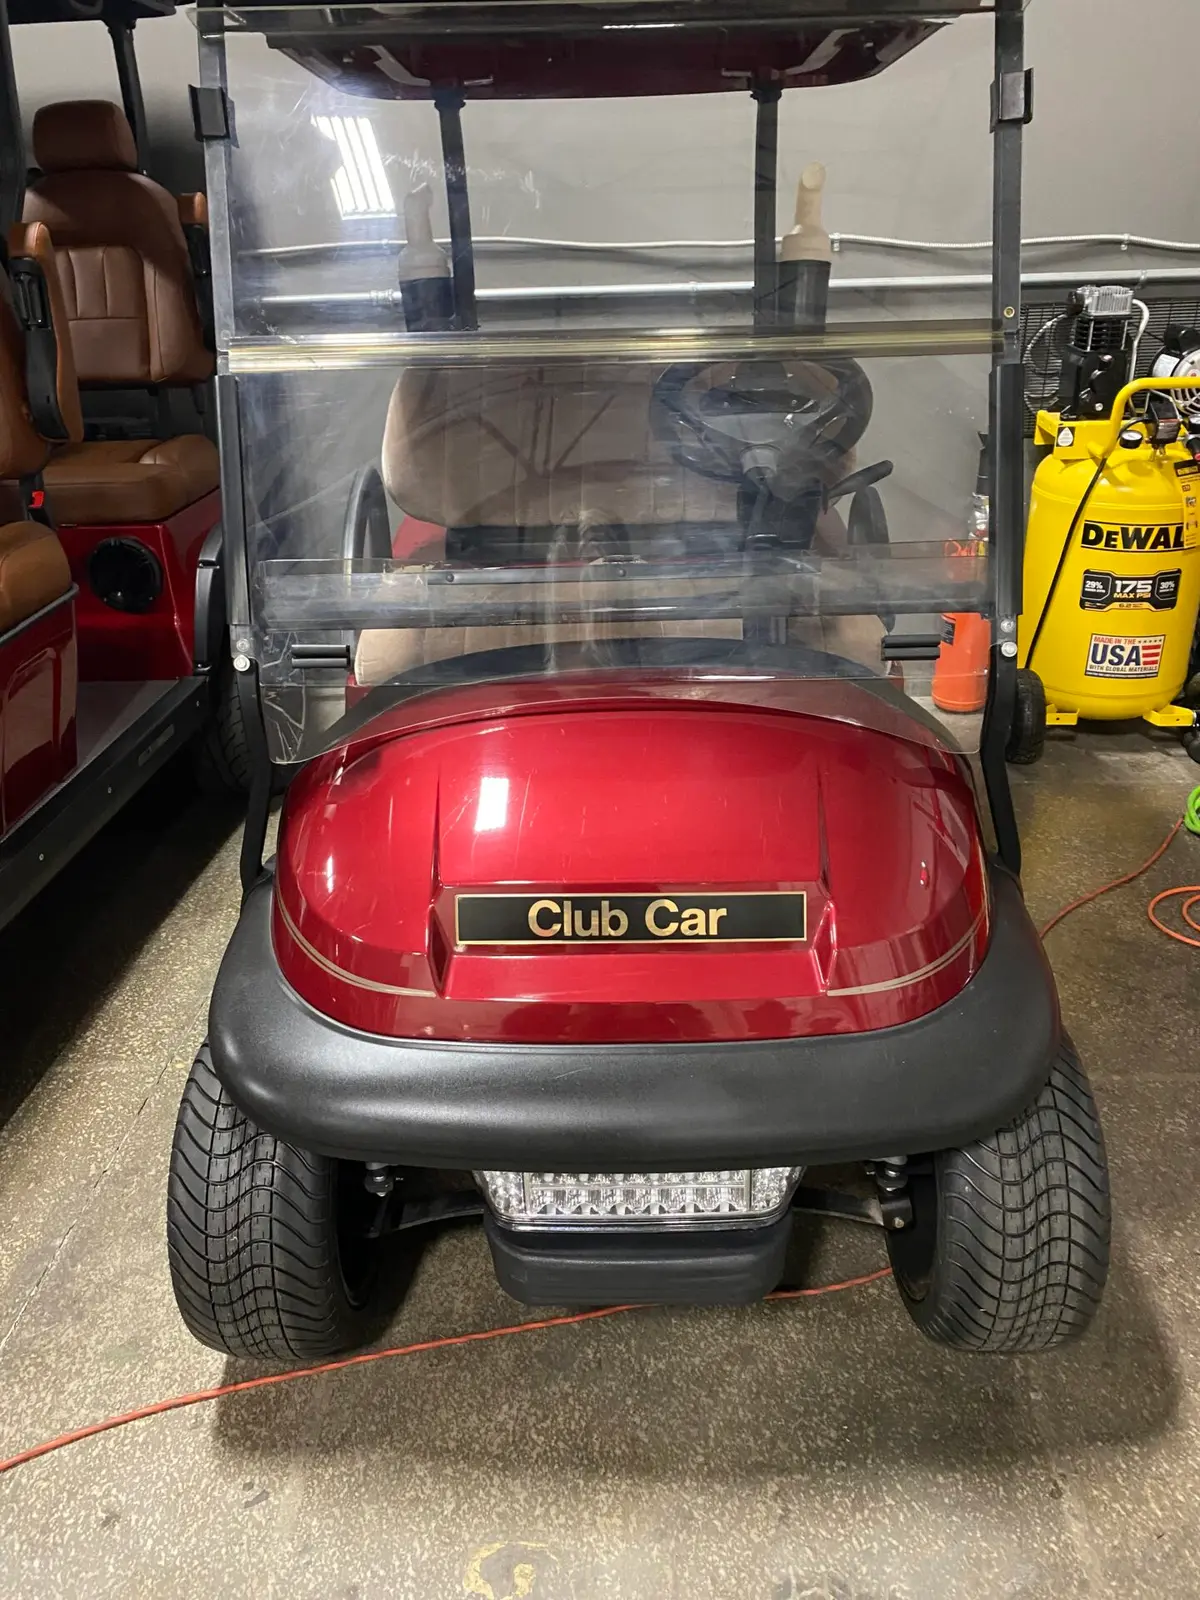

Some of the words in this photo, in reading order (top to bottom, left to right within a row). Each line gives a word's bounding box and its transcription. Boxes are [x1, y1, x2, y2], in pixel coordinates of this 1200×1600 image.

[1081, 523, 1184, 549] DEWAL
[1085, 580, 1103, 589] 29%
[1115, 580, 1153, 593] 175
[1094, 636, 1114, 644] MADE
[1091, 643, 1141, 666] USA
[528, 899, 629, 937] Club
[645, 899, 727, 937] Car
